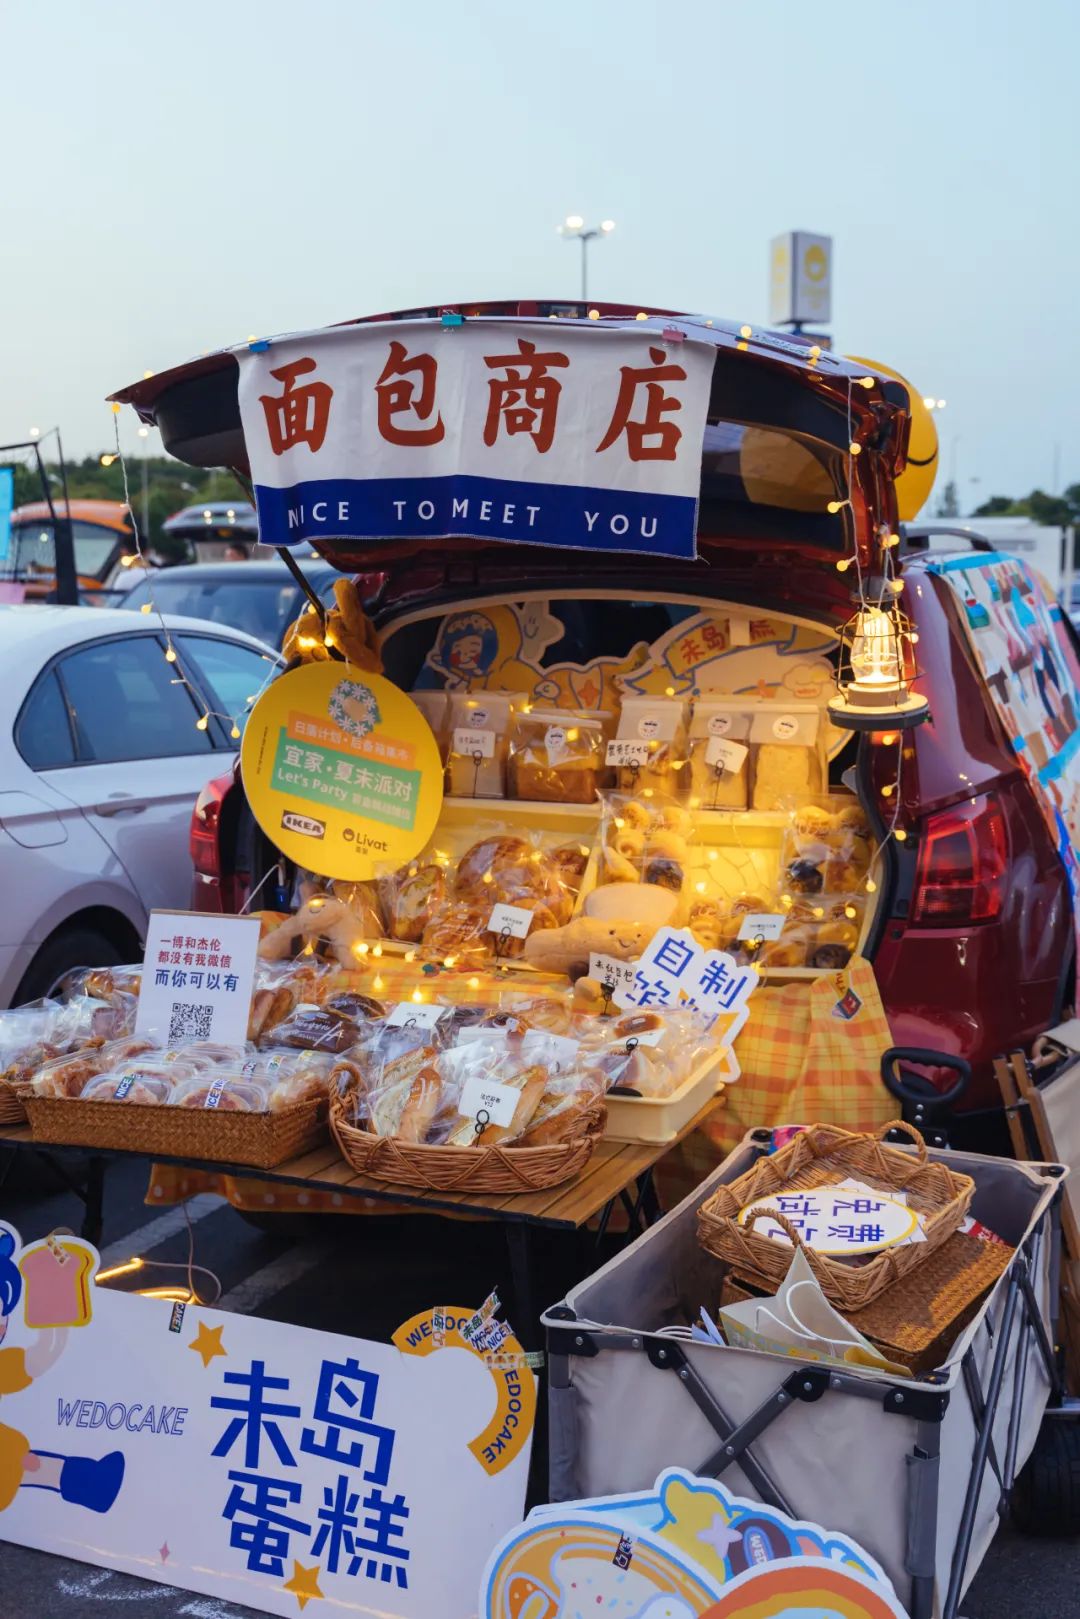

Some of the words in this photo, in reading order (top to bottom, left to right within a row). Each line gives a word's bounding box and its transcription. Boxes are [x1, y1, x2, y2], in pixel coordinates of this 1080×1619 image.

[258, 338, 688, 462] 面包商店
[288, 502, 350, 528] NICE
[583, 511, 658, 538] YOU
[278, 768, 308, 788] Let's
[312, 779, 348, 801] Party
[285, 815, 322, 834] IKEA
[356, 833, 387, 852] Livat
[158, 951, 232, 968] 都没有我微信
[160, 936, 221, 951] 一博和杰伦
[155, 969, 239, 992] 而你可以有
[653, 936, 747, 1009] 自制
[57, 1398, 188, 1436] WEDOCAKE
[210, 1357, 396, 1486] 未岛
[481, 1369, 522, 1464] EDOCAKE
[222, 1470, 410, 1589] 蛋糕
